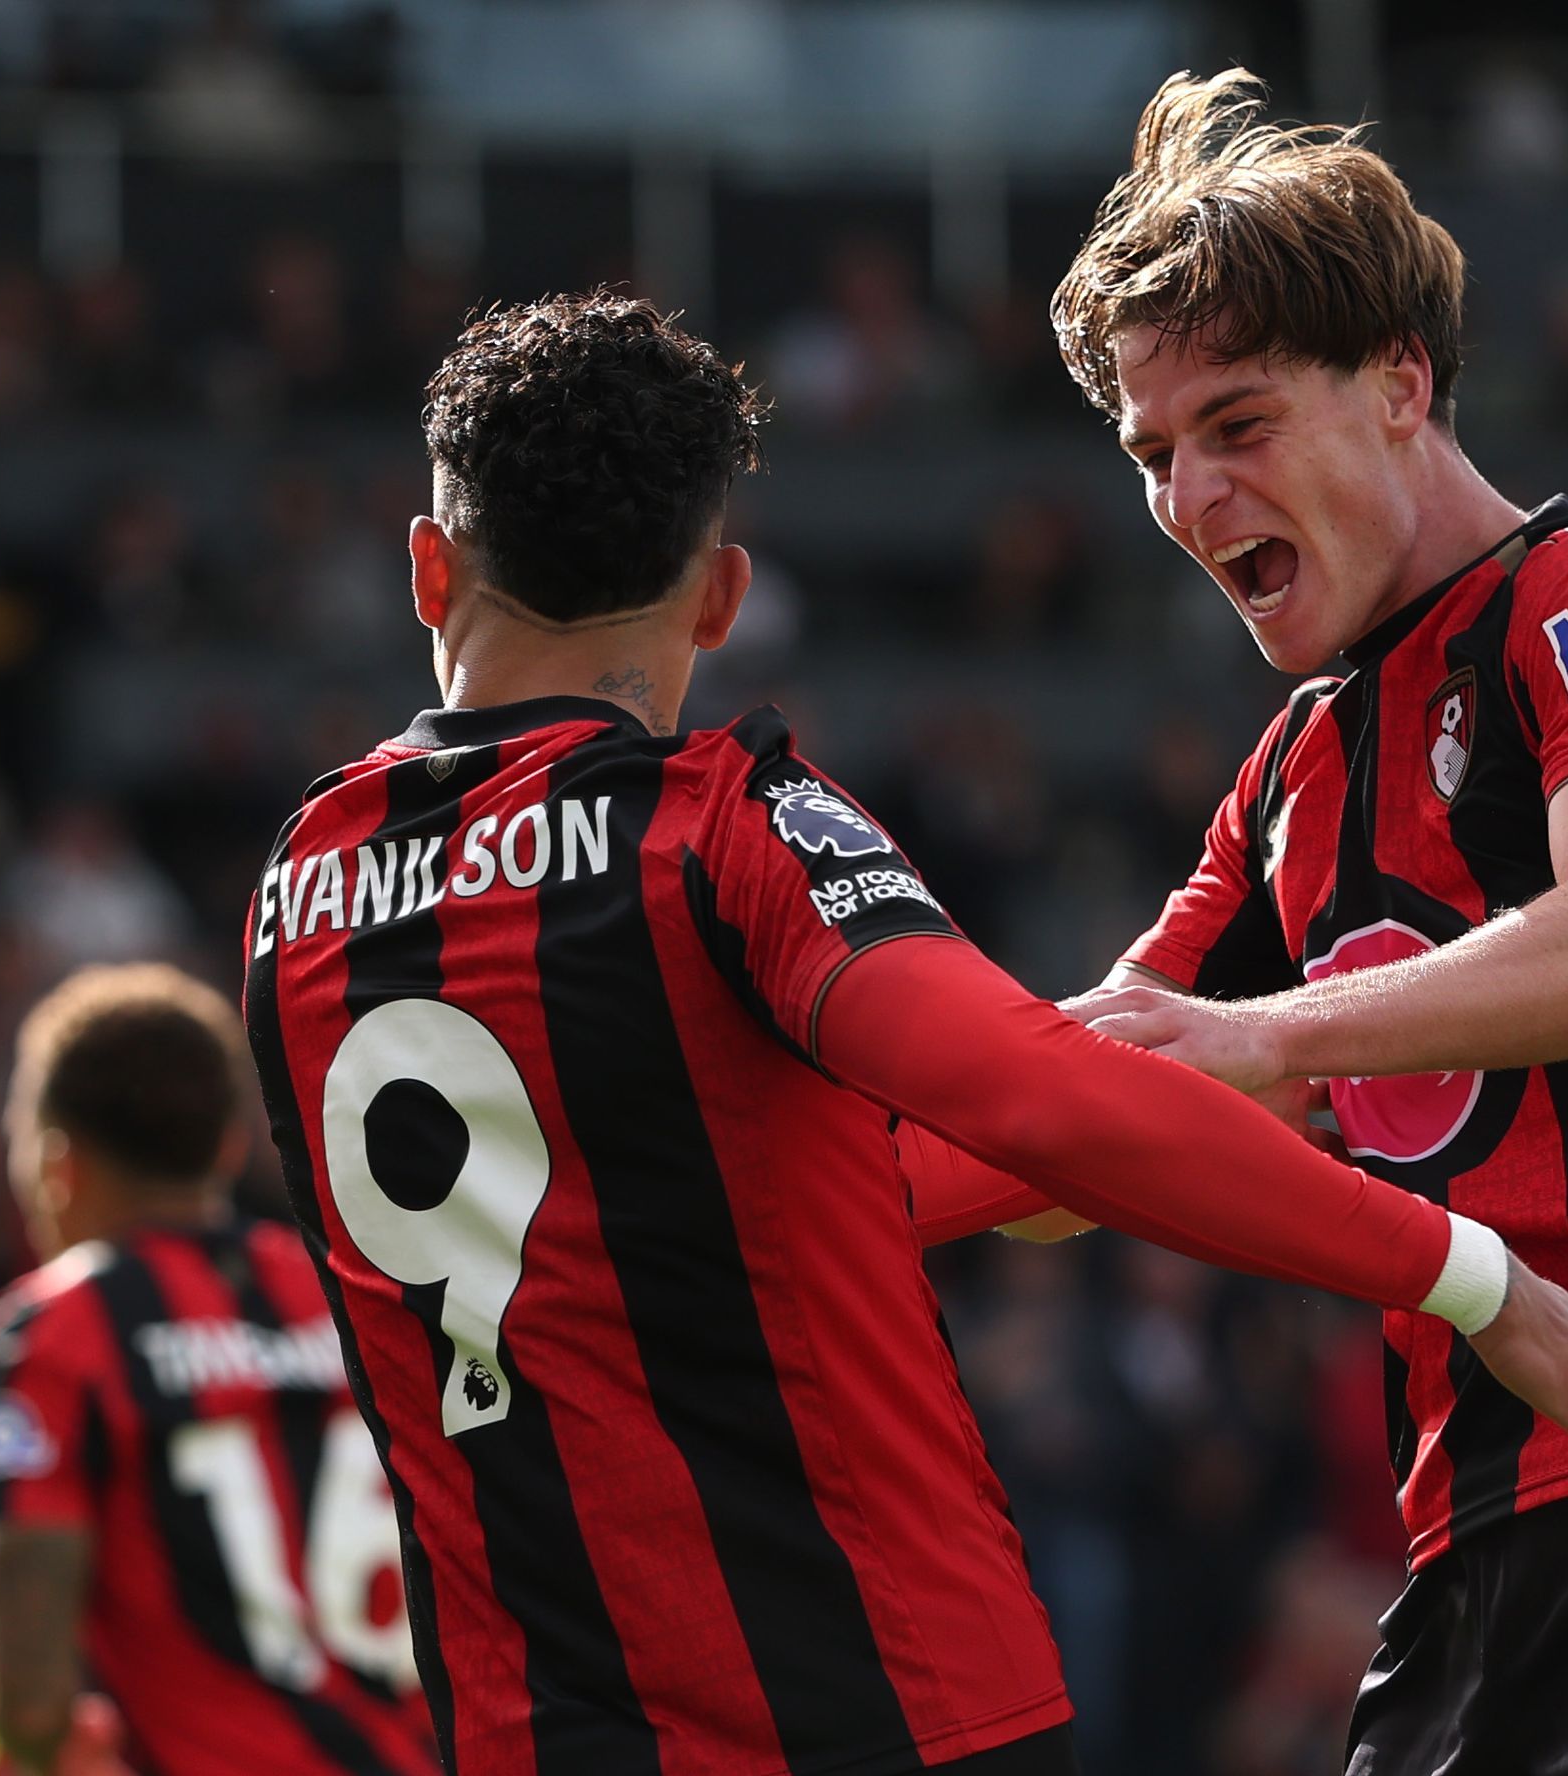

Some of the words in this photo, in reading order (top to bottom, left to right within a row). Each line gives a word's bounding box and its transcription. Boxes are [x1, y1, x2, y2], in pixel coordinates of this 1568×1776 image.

[253, 796, 612, 960] EVANILSON
[809, 879, 854, 912] No
[819, 895, 858, 927] for
[322, 998, 552, 1438] 9
[169, 1408, 423, 1693] 16
